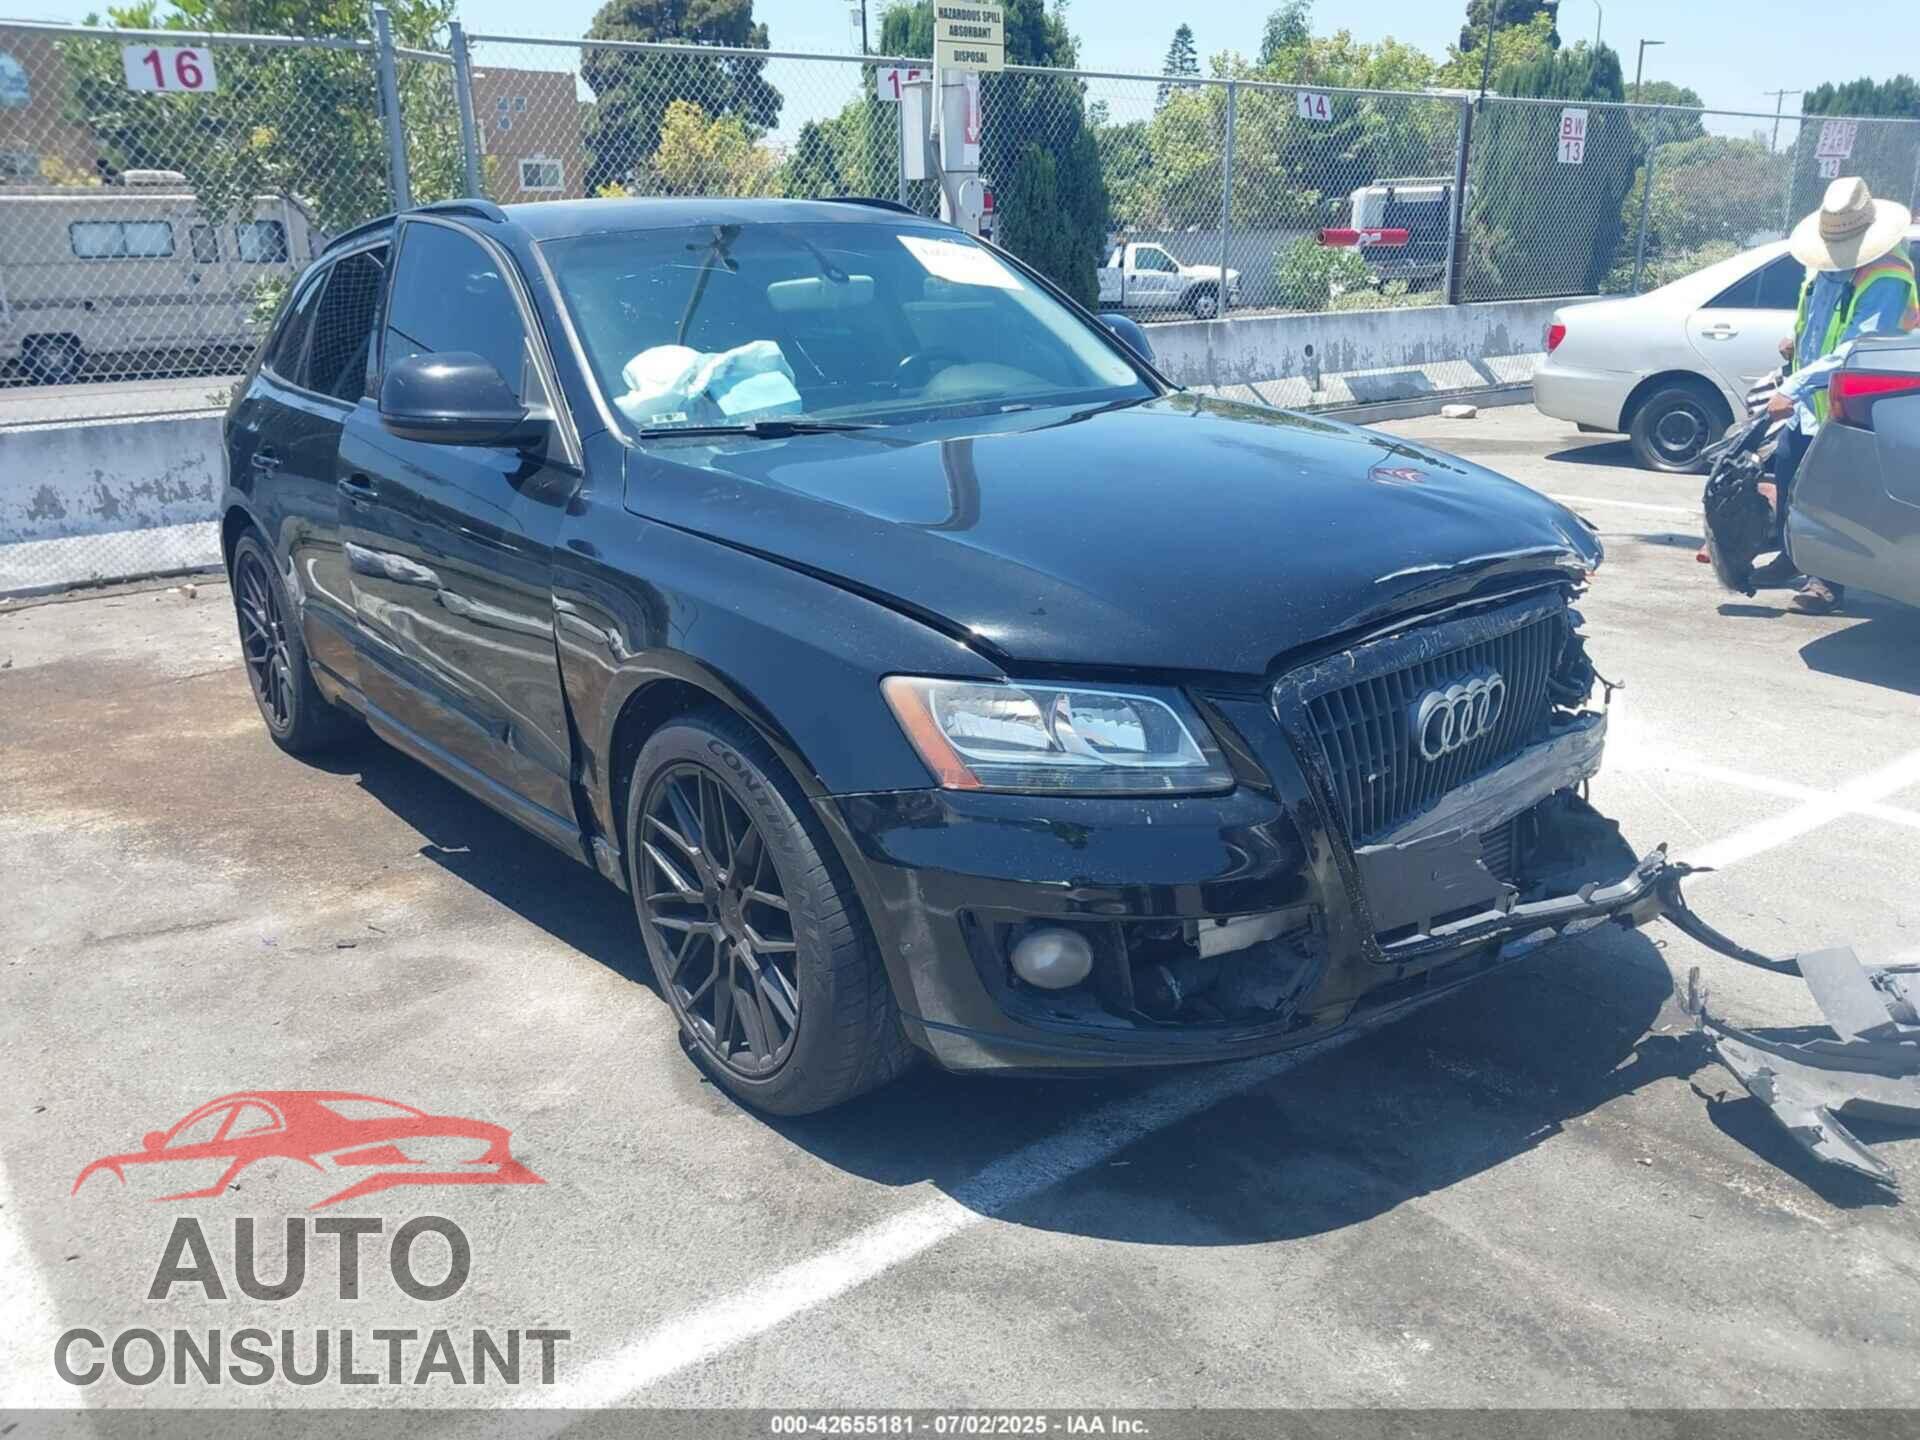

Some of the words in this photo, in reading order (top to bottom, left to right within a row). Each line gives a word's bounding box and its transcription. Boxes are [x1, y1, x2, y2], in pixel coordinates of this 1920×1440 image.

[938, 7, 981, 21] HAZARDOUS
[982, 11, 1000, 23] SPILL
[953, 50, 988, 63] DISPOSAL
[143, 49, 203, 89] 16
[1304, 95, 1327, 118] 14
[1563, 116, 1584, 135] BW
[1564, 142, 1581, 161] 13
[1823, 159, 1839, 176] 12
